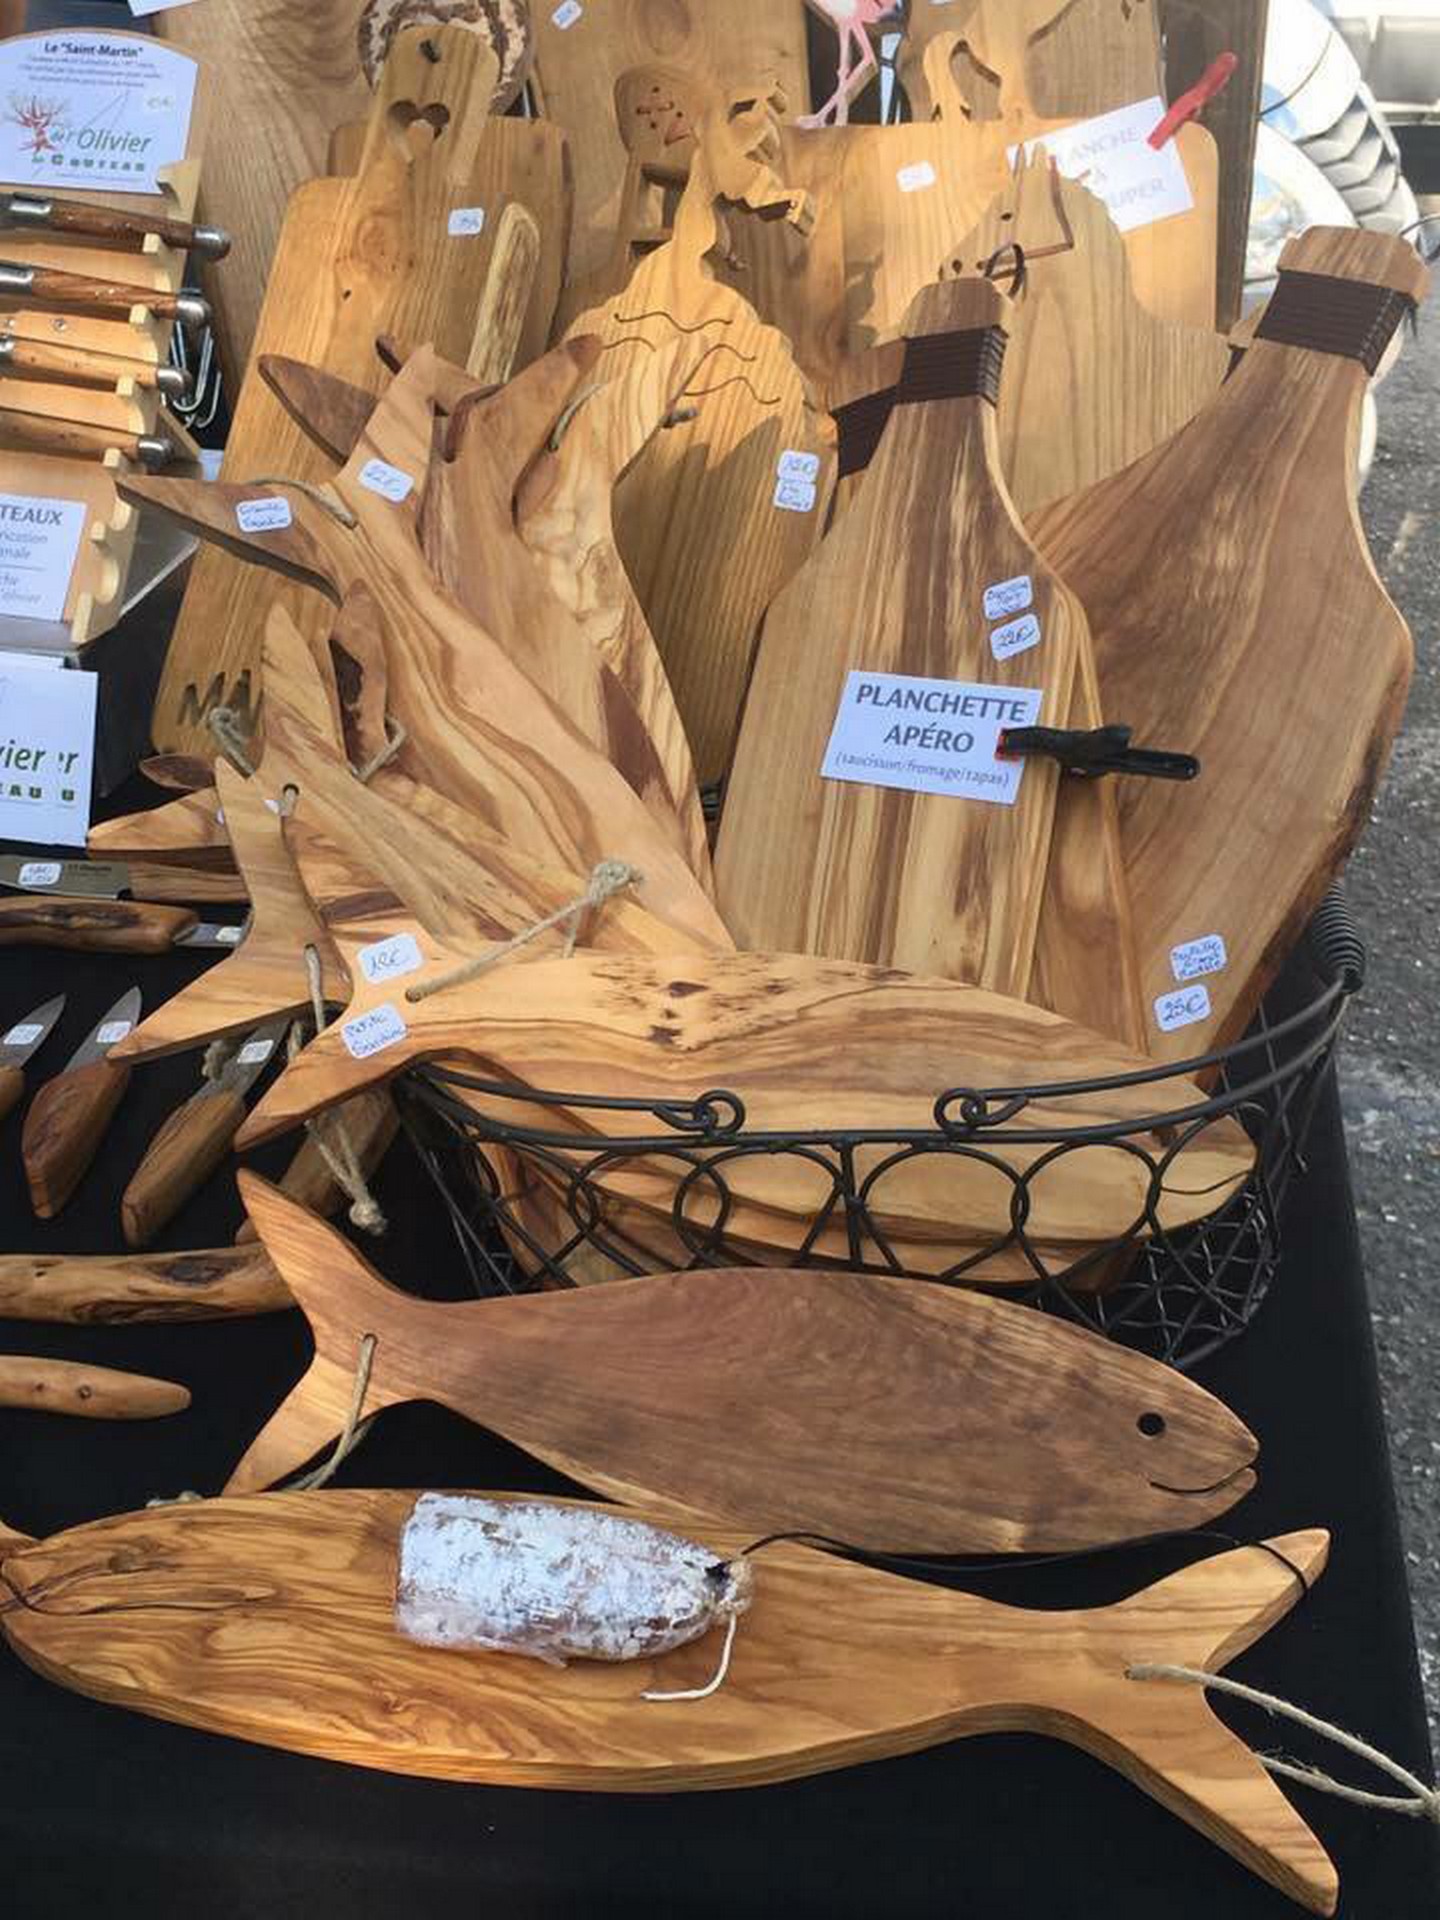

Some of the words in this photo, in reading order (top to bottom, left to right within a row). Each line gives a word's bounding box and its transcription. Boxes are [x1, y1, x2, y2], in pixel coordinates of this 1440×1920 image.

[45, 43, 58, 53] Le
[77, 128, 152, 153] Olivier
[856, 684, 1028, 723] PLANCHETTE
[884, 722, 974, 754] APÉRO
